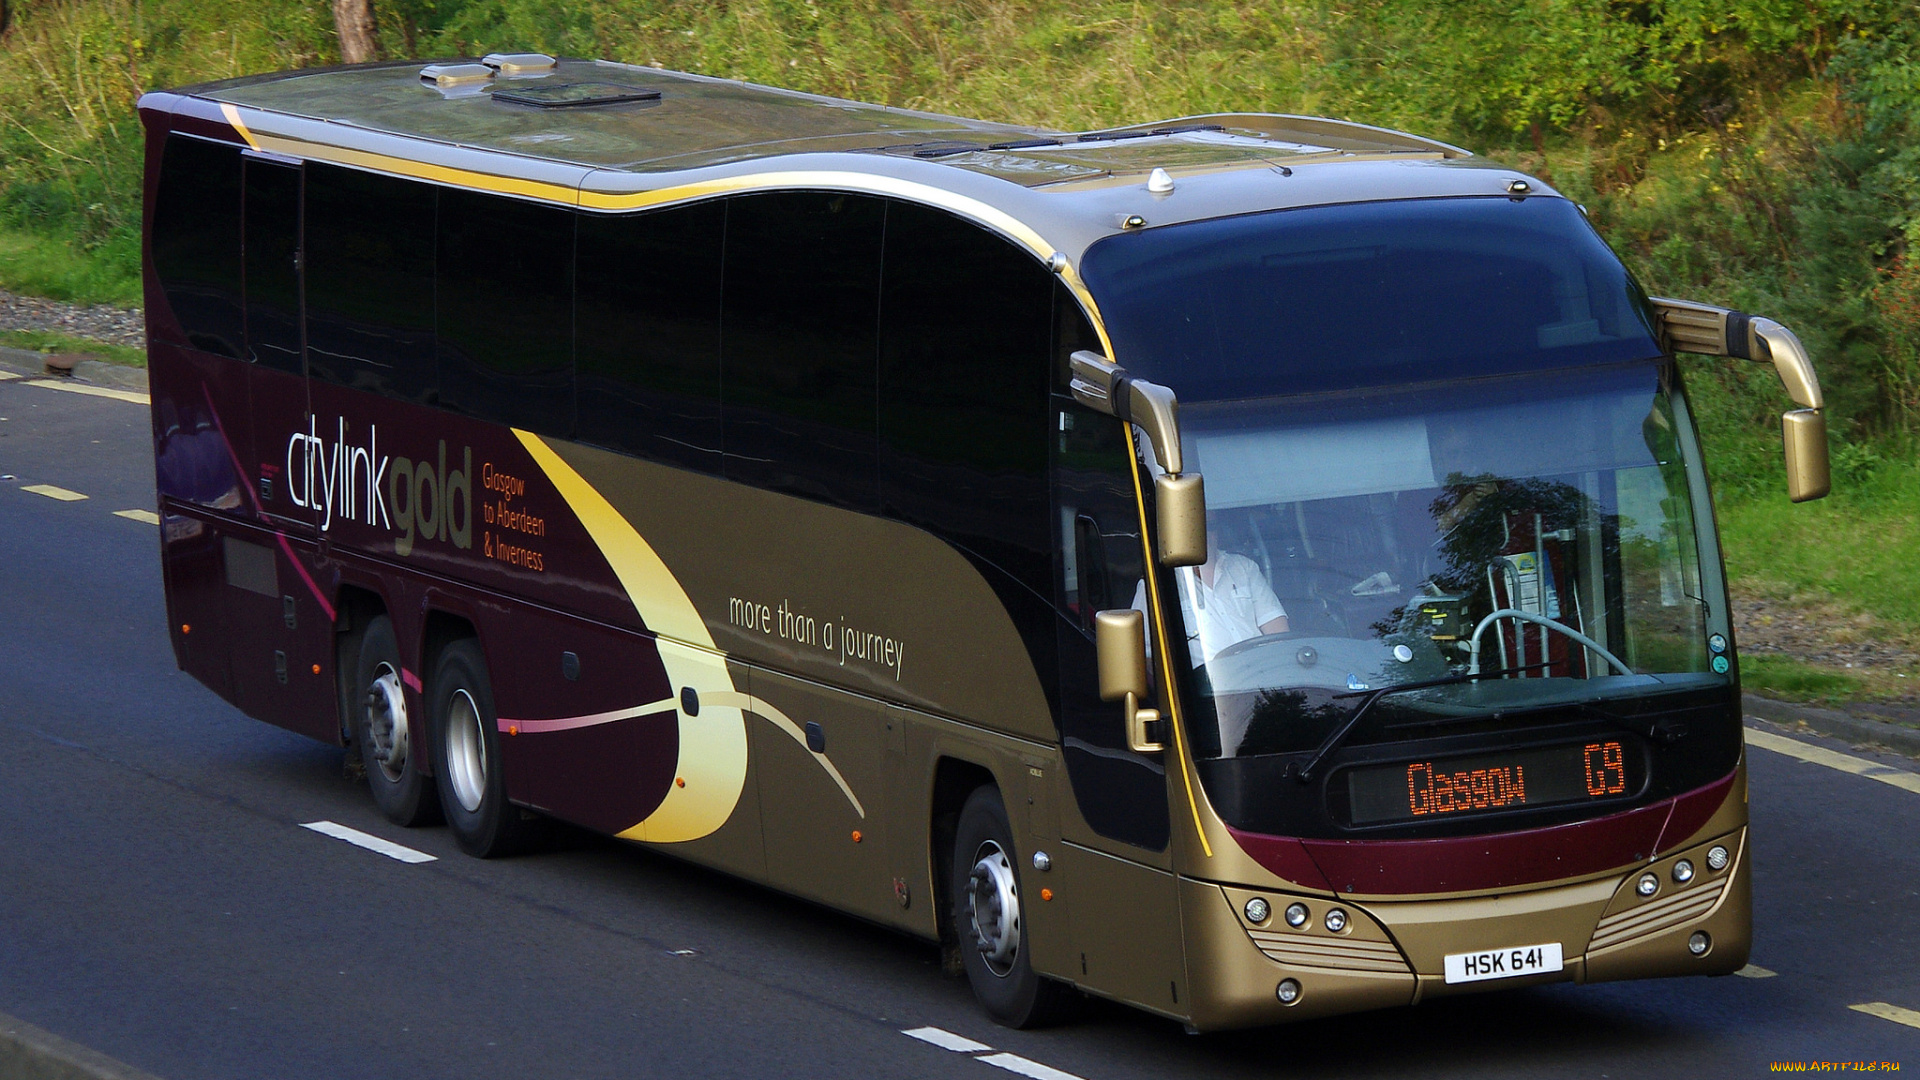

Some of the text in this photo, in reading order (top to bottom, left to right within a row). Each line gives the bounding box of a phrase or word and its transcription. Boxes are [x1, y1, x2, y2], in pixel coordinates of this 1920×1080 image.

[482, 462, 525, 501] Glasgow
[484, 500, 545, 538] to Aberdeen
[484, 534, 544, 572] & Inverness
[729, 596, 904, 681] more than a journey
[1407, 742, 1625, 815] Glasgow G9
[1464, 947, 1543, 976] HSK 641
